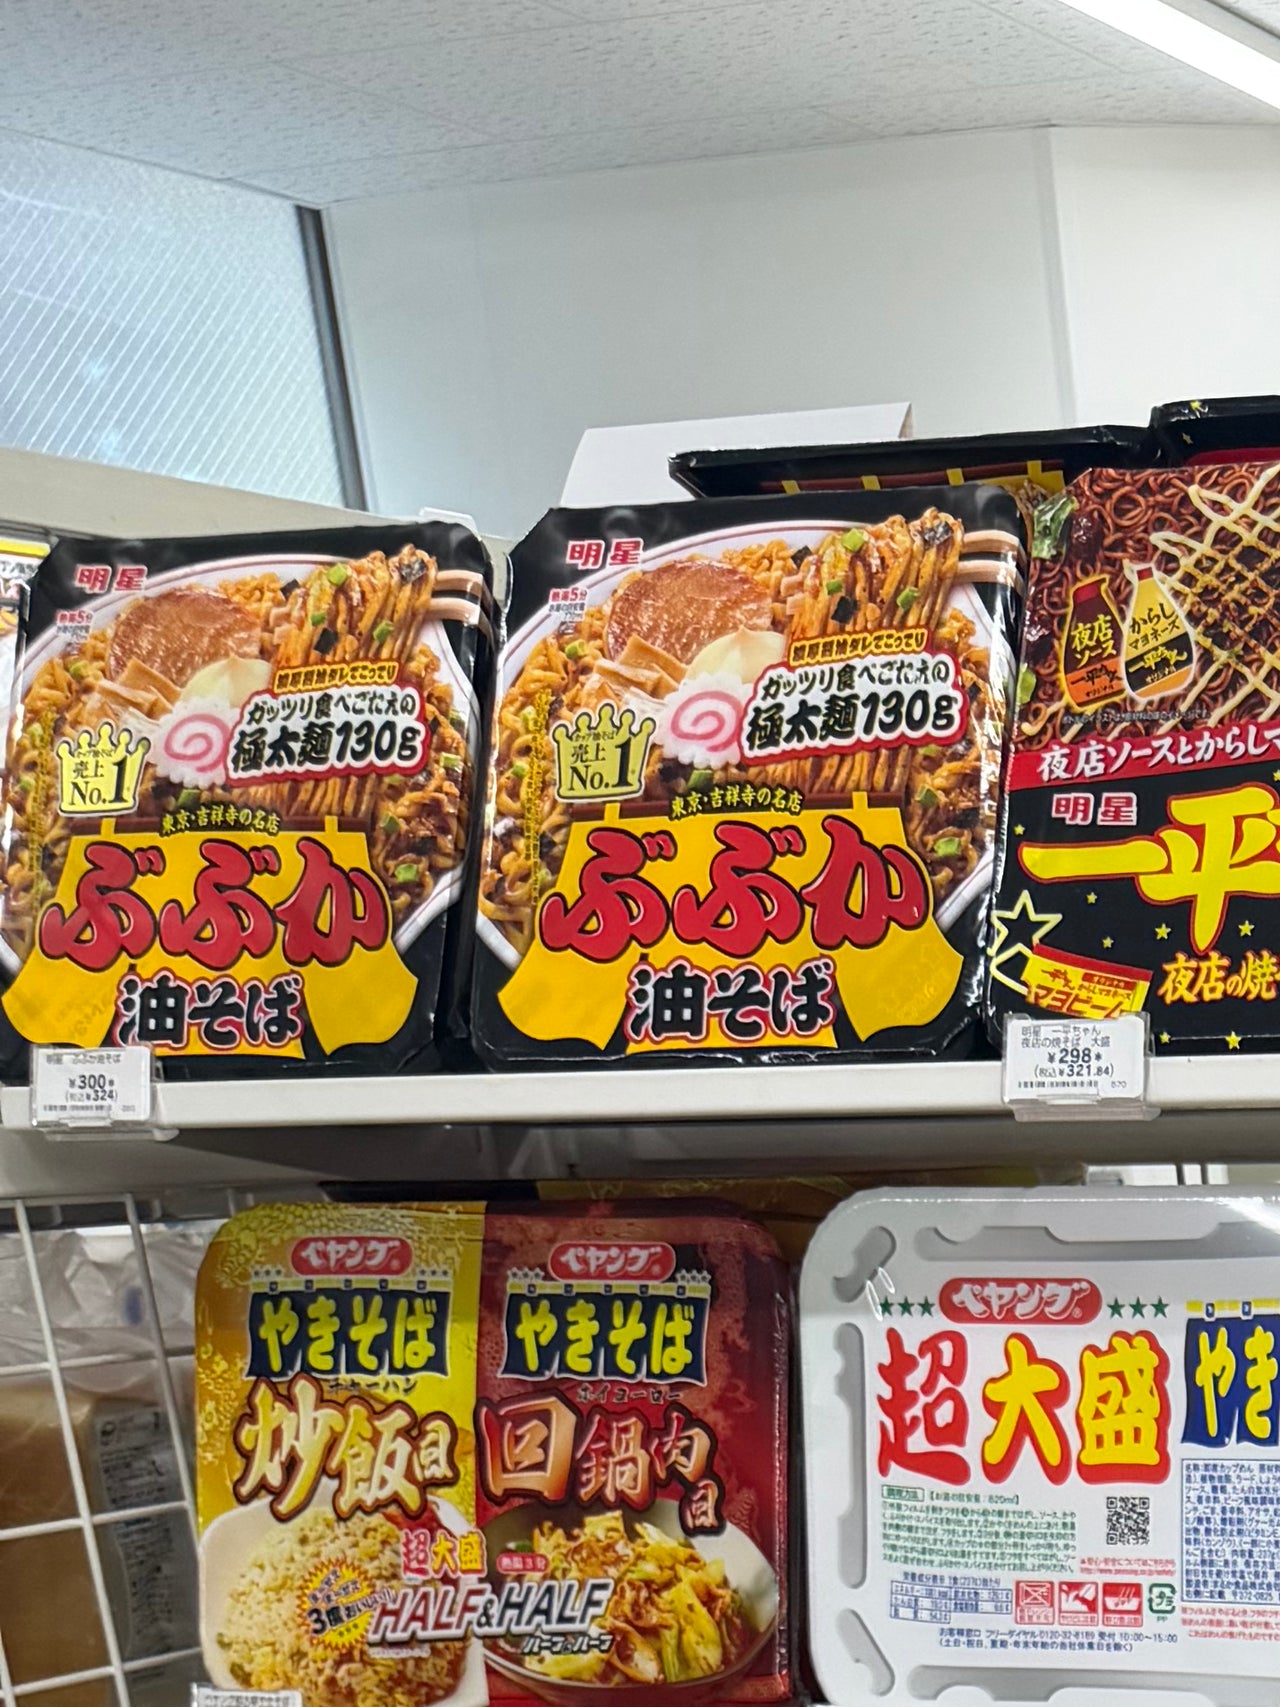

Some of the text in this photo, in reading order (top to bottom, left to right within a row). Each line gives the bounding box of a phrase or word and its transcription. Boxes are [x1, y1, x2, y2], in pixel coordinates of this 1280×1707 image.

[566, 538, 643, 565] 明星
[76, 565, 146, 593] 明星
[246, 692, 416, 726] ガッツリ食べごたえの
[761, 664, 950, 701] ガッツリ食べごたえの
[744, 688, 961, 750] 極太麺130g
[232, 722, 427, 776] 極太麺130g
[1051, 793, 1138, 826] 明星
[41, 837, 387, 970] ぶぶか
[541, 817, 927, 959] ぶぶか
[118, 974, 305, 1049] 油そば
[628, 960, 838, 1042] 油そば
[300, 1238, 394, 1274] ペヤング
[560, 1244, 654, 1282] ペヤング
[948, 1281, 1085, 1320] ペヤング
[259, 1298, 437, 1378] やきそば
[515, 1300, 694, 1378] やきそば
[877, 1329, 1170, 1486] 超大盛
[401, 1528, 486, 1577] 超大盛
[369, 1578, 613, 1641] HALF&HALF
